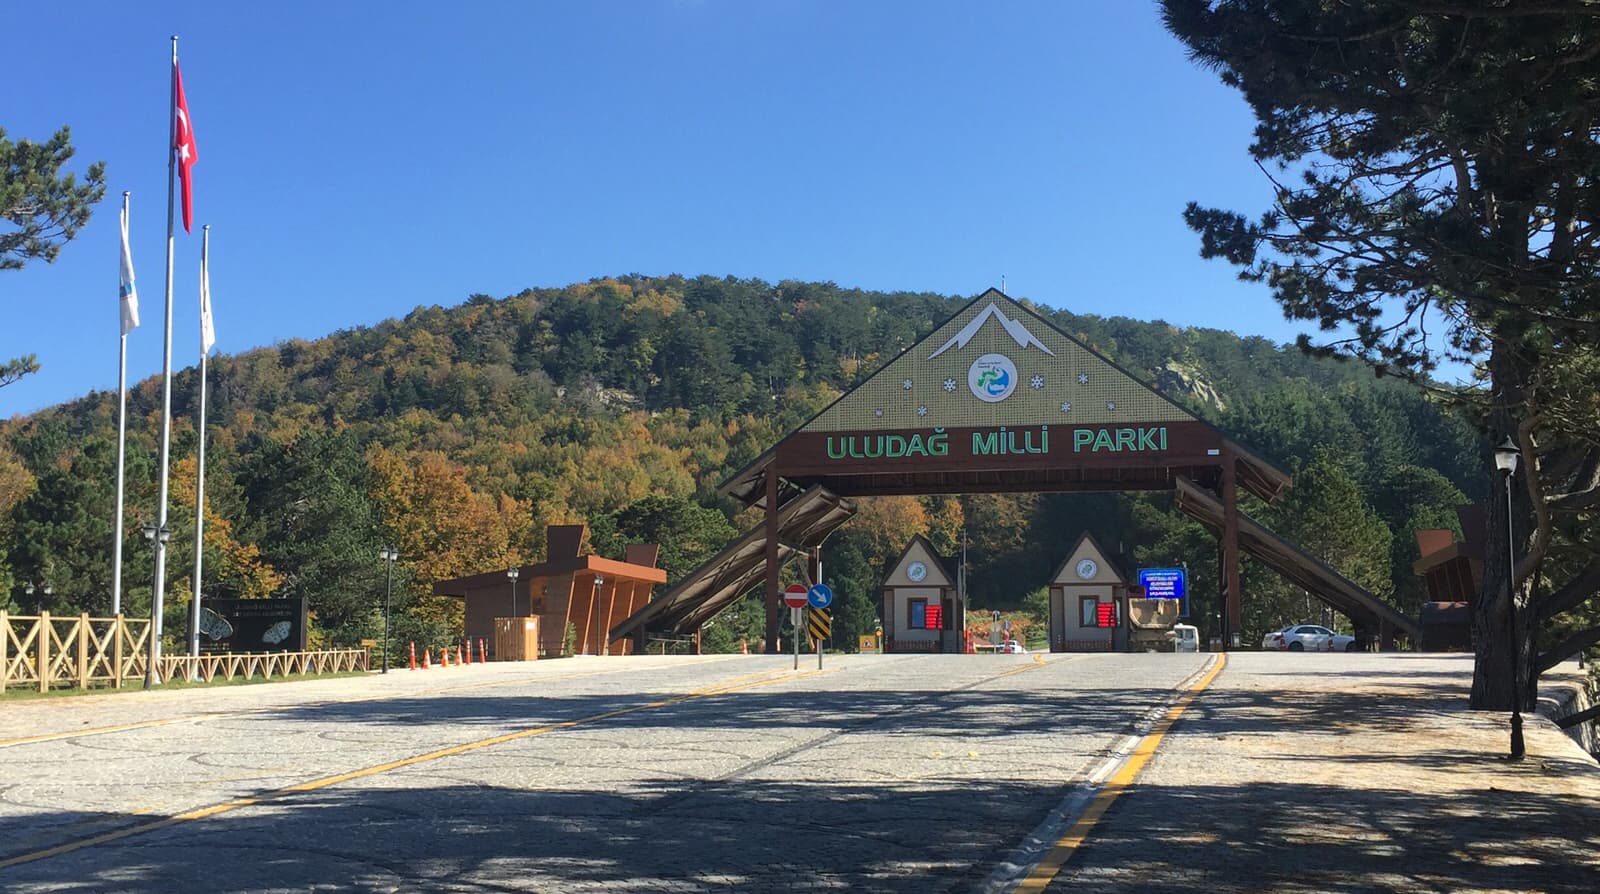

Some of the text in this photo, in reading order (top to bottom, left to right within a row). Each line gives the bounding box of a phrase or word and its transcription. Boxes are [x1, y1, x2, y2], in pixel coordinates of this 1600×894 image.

[827, 425, 1168, 459] ULUDAĞ MİLLİ PARKI
